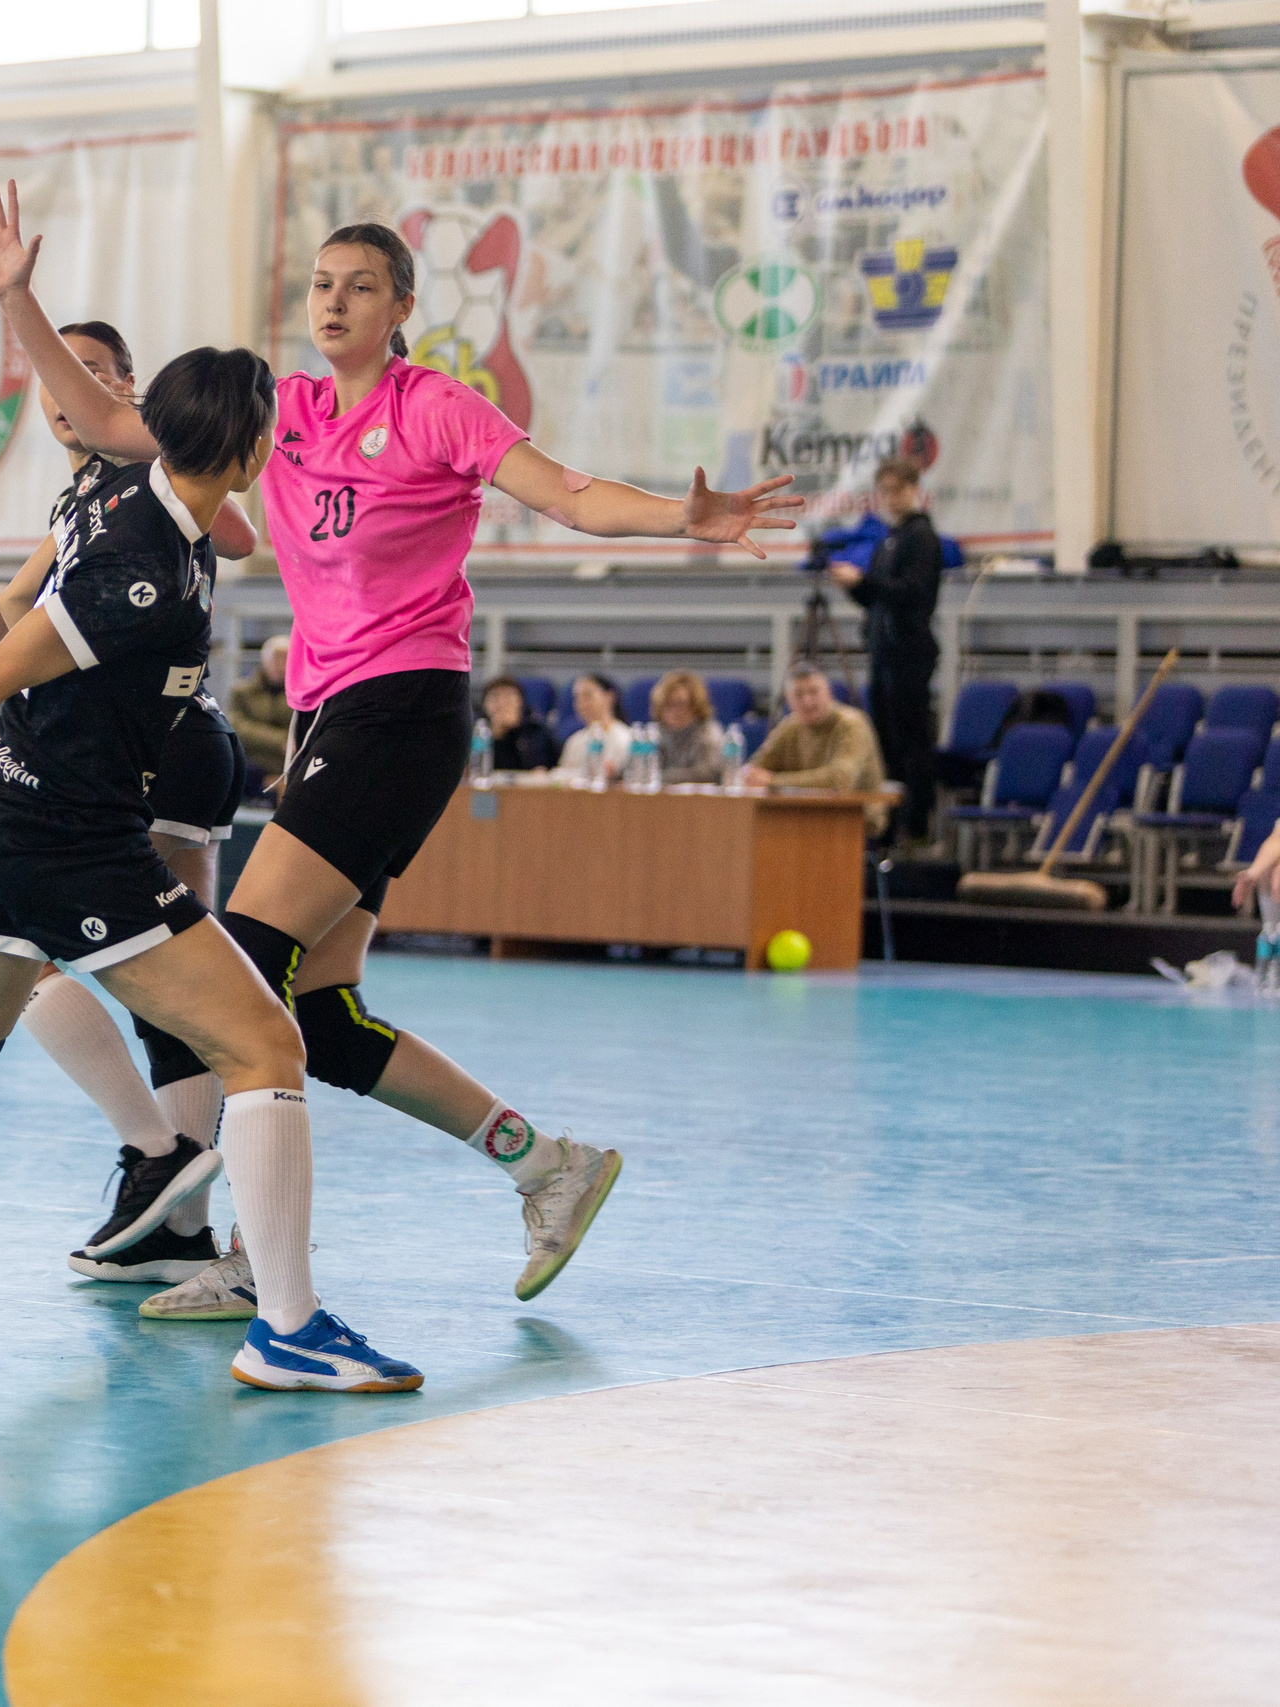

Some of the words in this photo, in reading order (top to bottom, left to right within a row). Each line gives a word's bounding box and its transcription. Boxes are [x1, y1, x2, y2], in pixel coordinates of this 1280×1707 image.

[760, 422, 897, 474] Kempa
[310, 485, 357, 542] 20
[161, 661, 206, 697] B
[155, 882, 189, 908] Kemp
